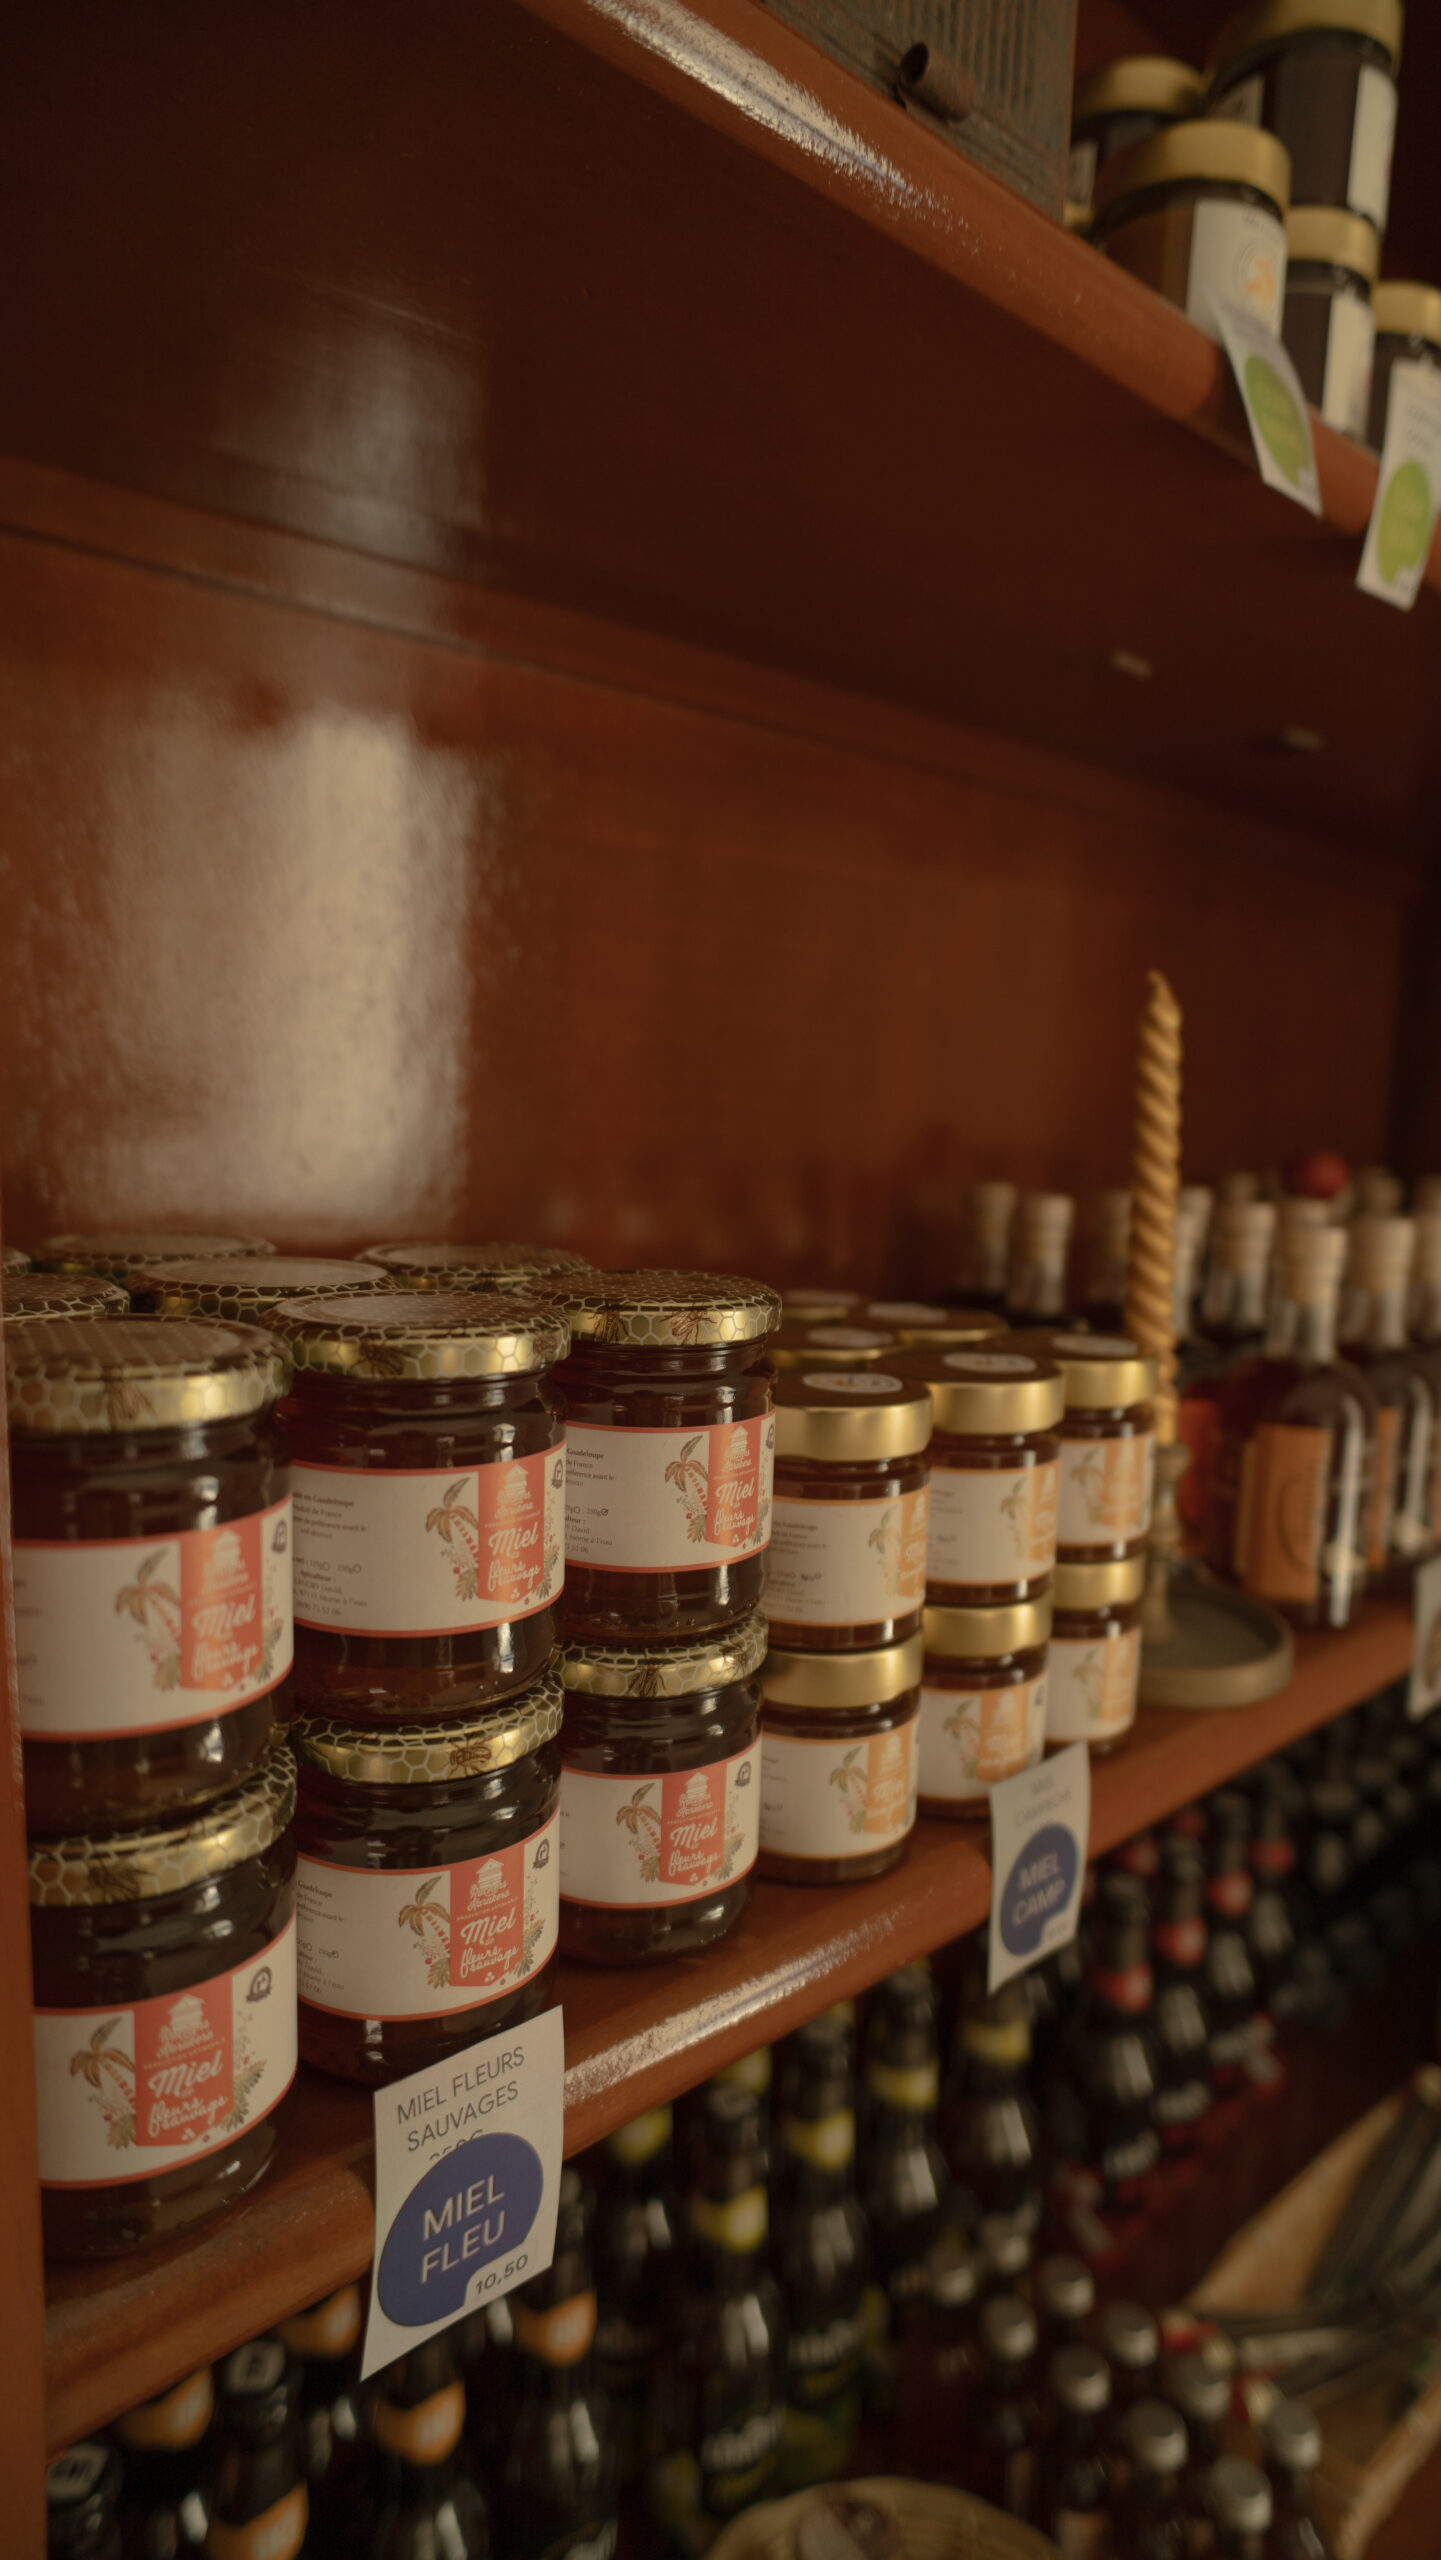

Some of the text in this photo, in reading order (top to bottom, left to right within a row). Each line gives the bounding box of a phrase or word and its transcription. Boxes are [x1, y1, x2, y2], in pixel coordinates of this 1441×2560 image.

[715, 1477, 756, 1507] Miel
[488, 1521, 540, 1558] Miel
[190, 1592, 257, 1639] Miel
[670, 1816, 719, 1850] Miel
[1016, 1848, 1063, 1894] MIEL
[460, 1906, 517, 1945] Miel
[1011, 1877, 1067, 1929] CAMP
[460, 1946, 502, 1979] fleurs
[147, 2050, 225, 2098] Miel
[395, 2045, 525, 2126] MIEL FLEURS
[406, 2079, 520, 2153] SAUVAGES
[422, 2172, 507, 2242] MIEL
[420, 2208, 507, 2287] FLEU
[474, 2252, 529, 2297] 10,50
